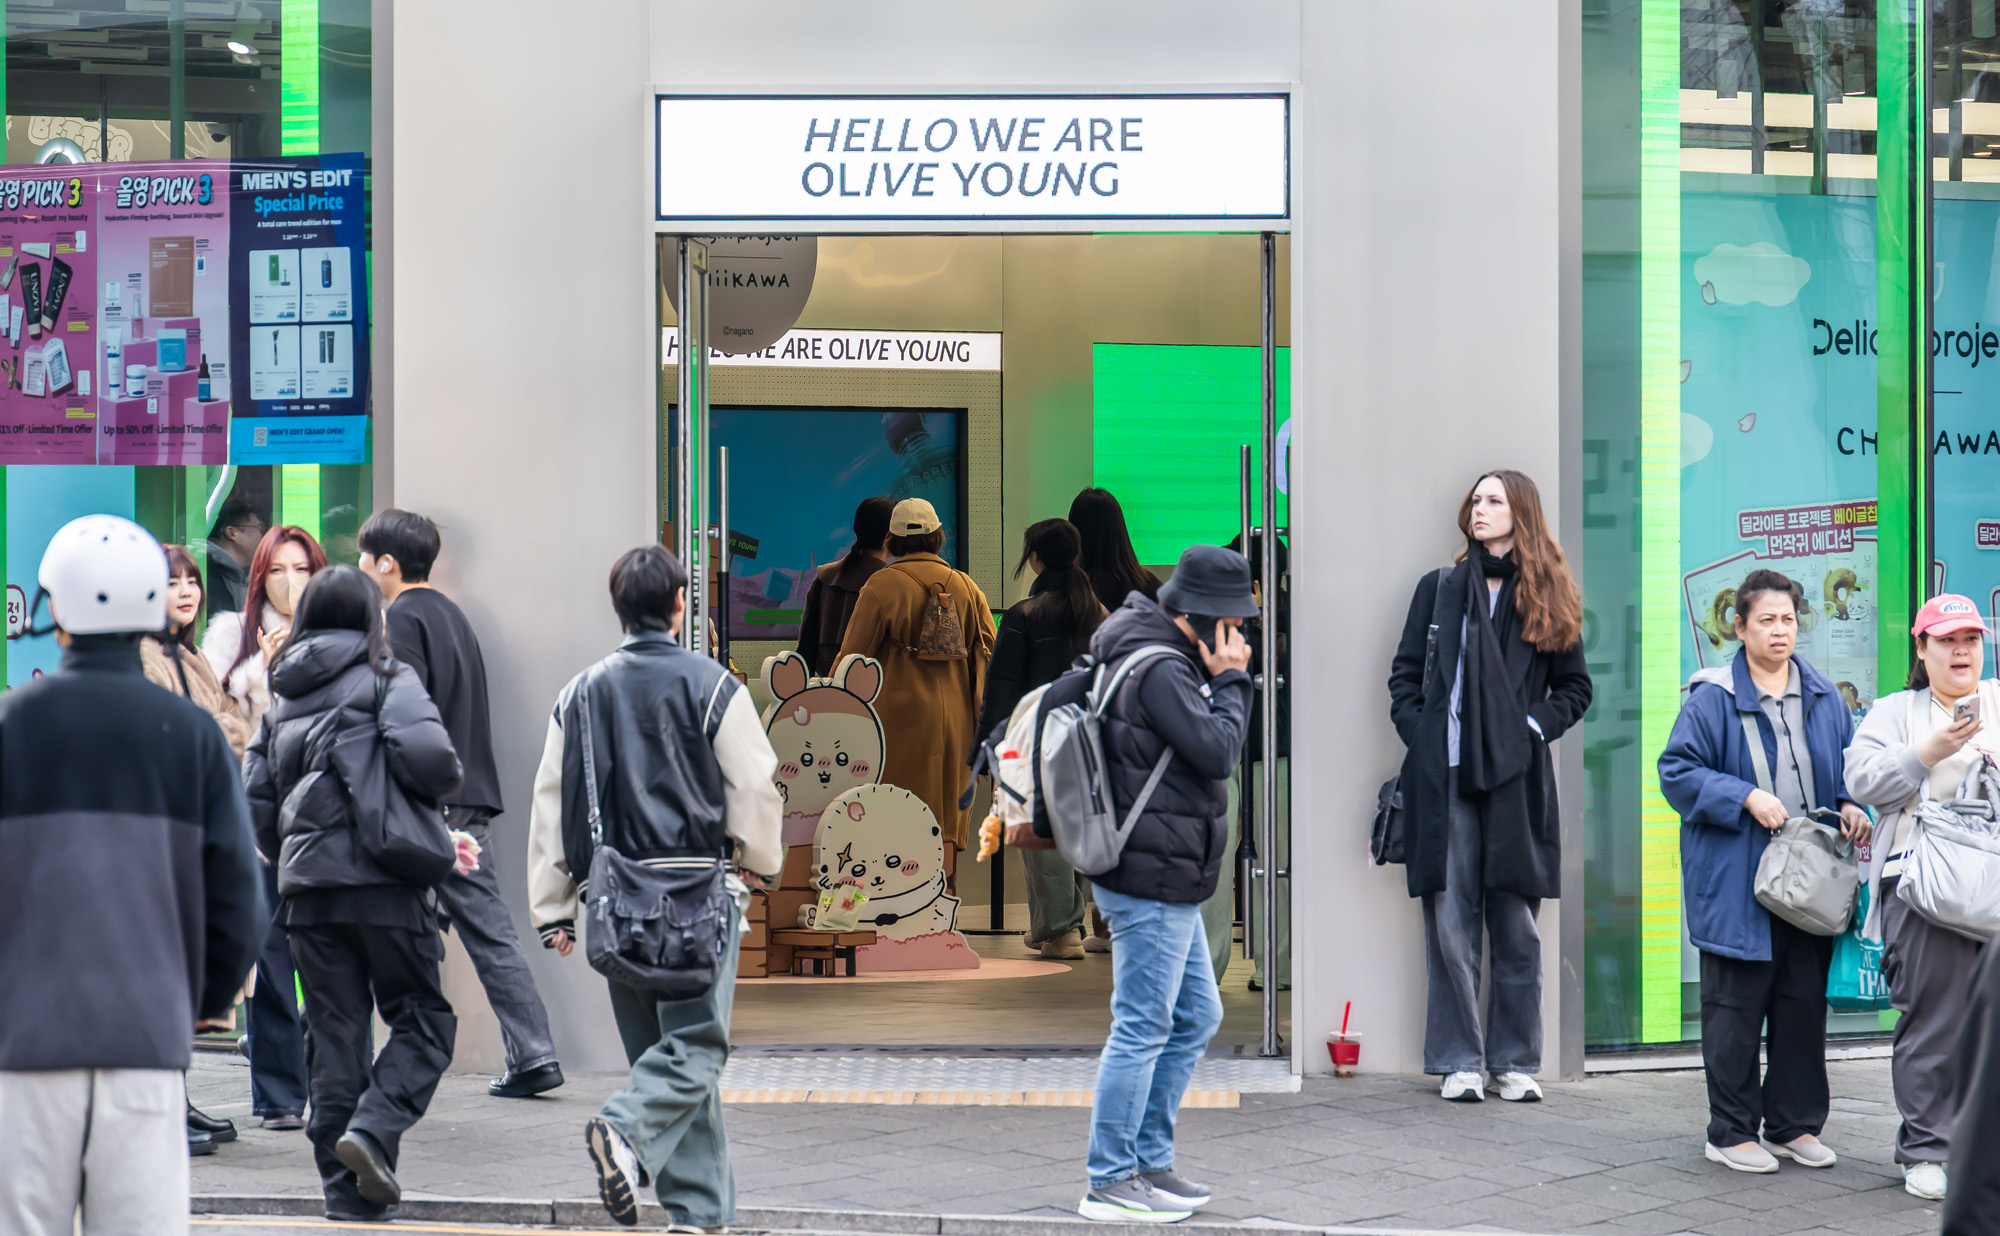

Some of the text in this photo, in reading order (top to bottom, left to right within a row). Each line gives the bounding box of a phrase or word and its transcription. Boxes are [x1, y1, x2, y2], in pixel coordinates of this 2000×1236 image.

[804, 118, 1143, 152] HELLO WE ARE
[68, 177, 82, 207] 3
[198, 174, 212, 204] 3
[242, 169, 353, 190] MEN'S EDIT
[801, 162, 1119, 197] OLIVE YOUNG
[254, 190, 344, 218] Special Price
[709, 269, 790, 288] iiKAWA
[781, 337, 823, 360] ARE
[828, 337, 892, 361] OLIVE
[896, 339, 970, 362] YOUNG
[1813, 318, 1878, 356] Deli
[12, 424, 25, 434] Off
[56, 424, 74, 434] Time
[75, 423, 93, 434] Offer
[104, 425, 115, 436] Up
[116, 425, 124, 434] to
[142, 424, 154, 434] Off
[187, 424, 205, 434] Time
[1741, 513, 1786, 534] 딜라이트
[1787, 509, 1832, 529] 프로젝트
[1770, 528, 1852, 556] 먼작귀 에디션
